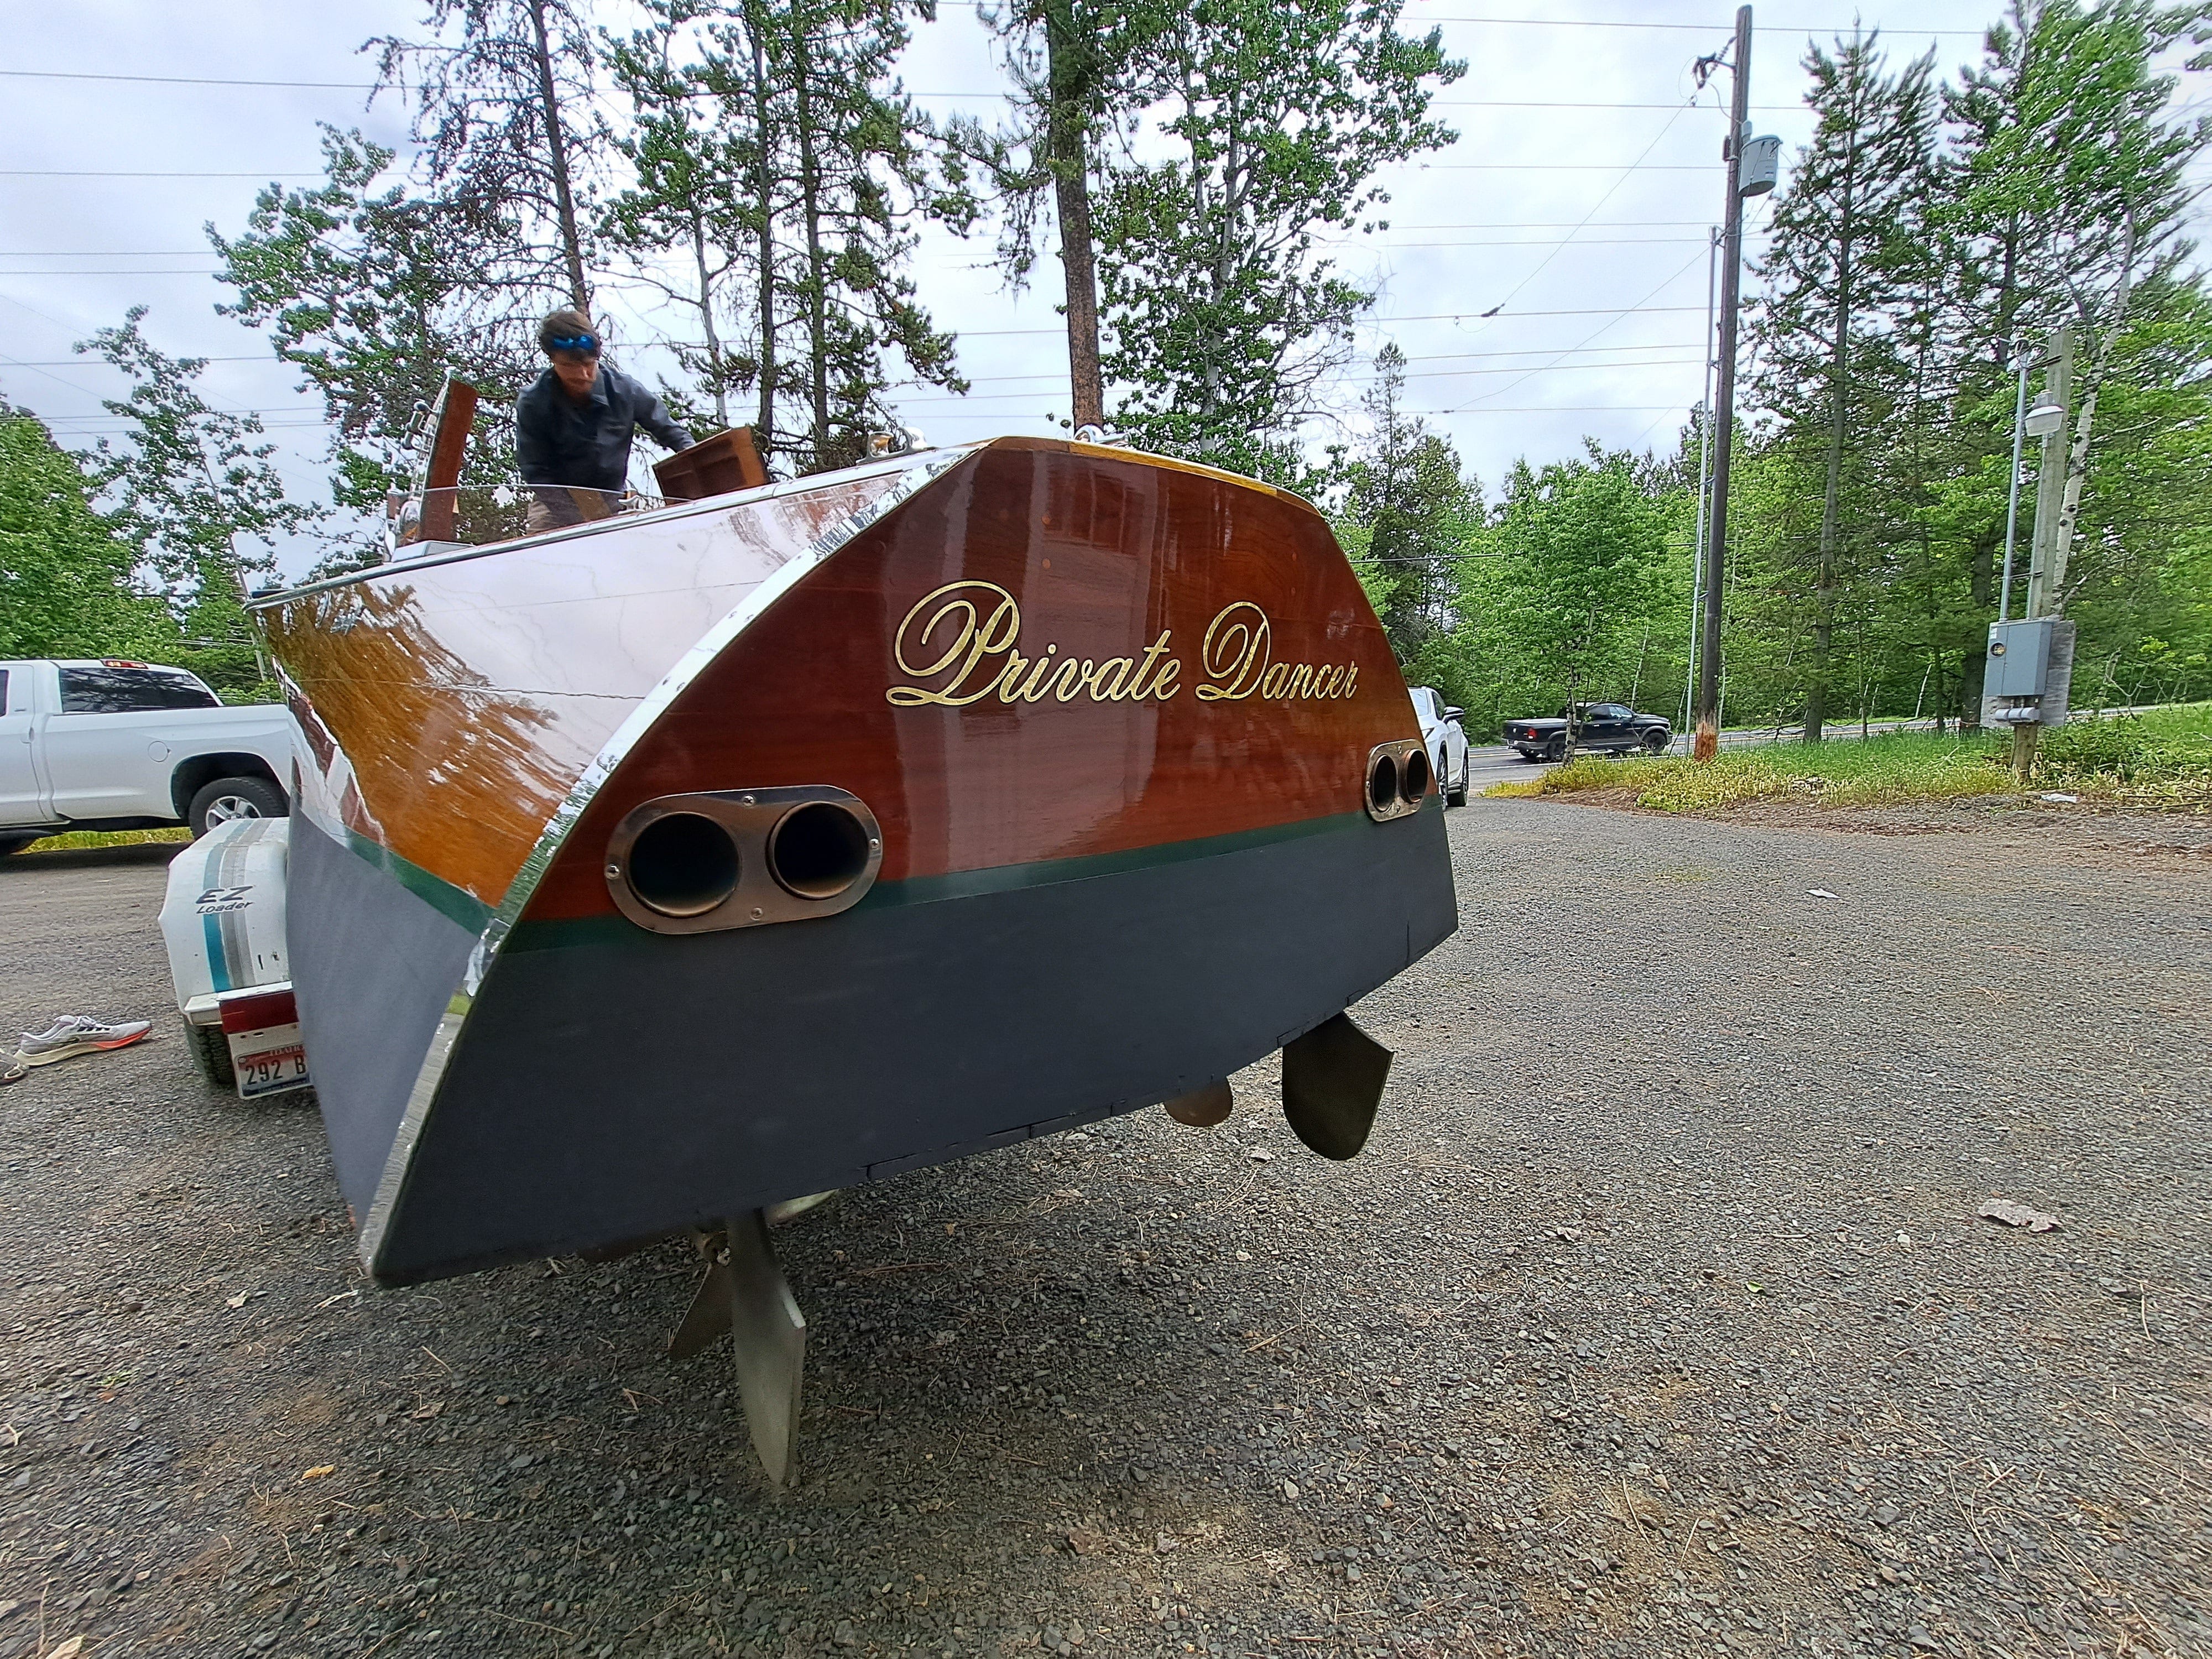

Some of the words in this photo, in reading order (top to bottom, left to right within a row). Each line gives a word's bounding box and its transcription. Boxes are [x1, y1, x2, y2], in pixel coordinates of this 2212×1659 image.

[885, 580, 1181, 707] Private
[1195, 601, 1358, 701] Dancer
[196, 885, 253, 904] EZ
[196, 901, 254, 914] Loader
[245, 1060, 283, 1086] 292
